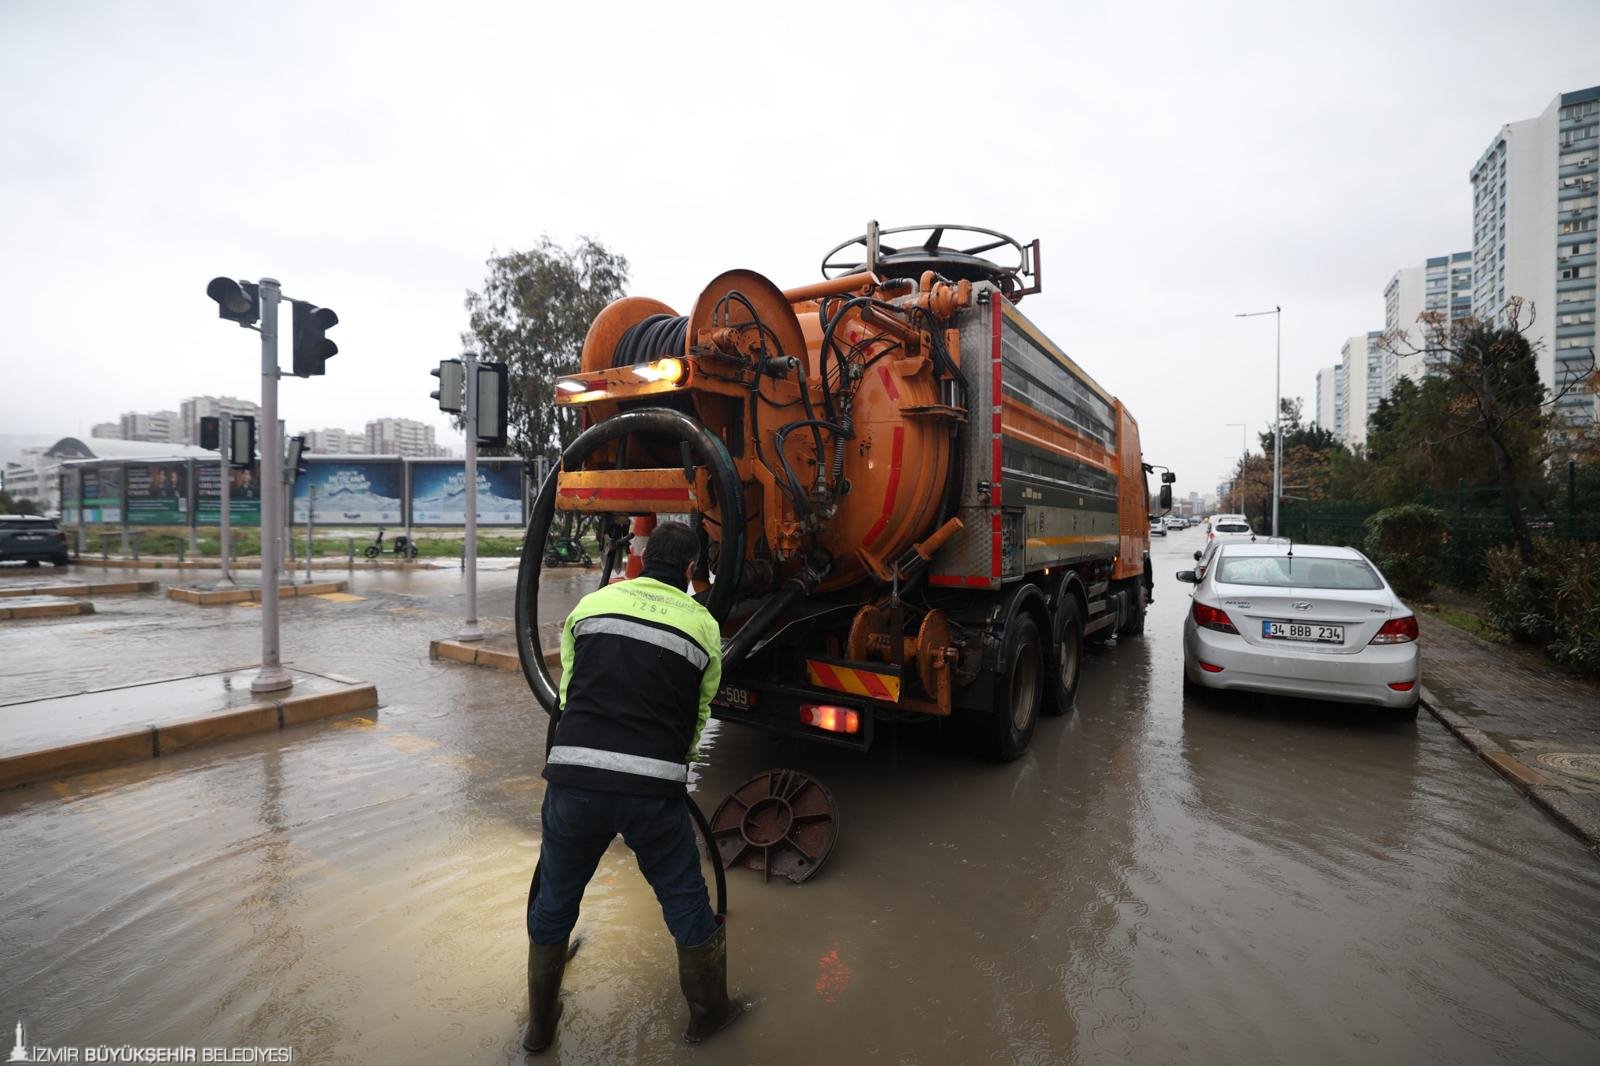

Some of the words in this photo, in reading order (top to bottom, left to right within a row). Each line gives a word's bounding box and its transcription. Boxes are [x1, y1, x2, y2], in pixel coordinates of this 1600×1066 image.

[1272, 624, 1284, 635] 34
[1290, 625, 1311, 637] BBB
[1318, 627, 1340, 640] 234
